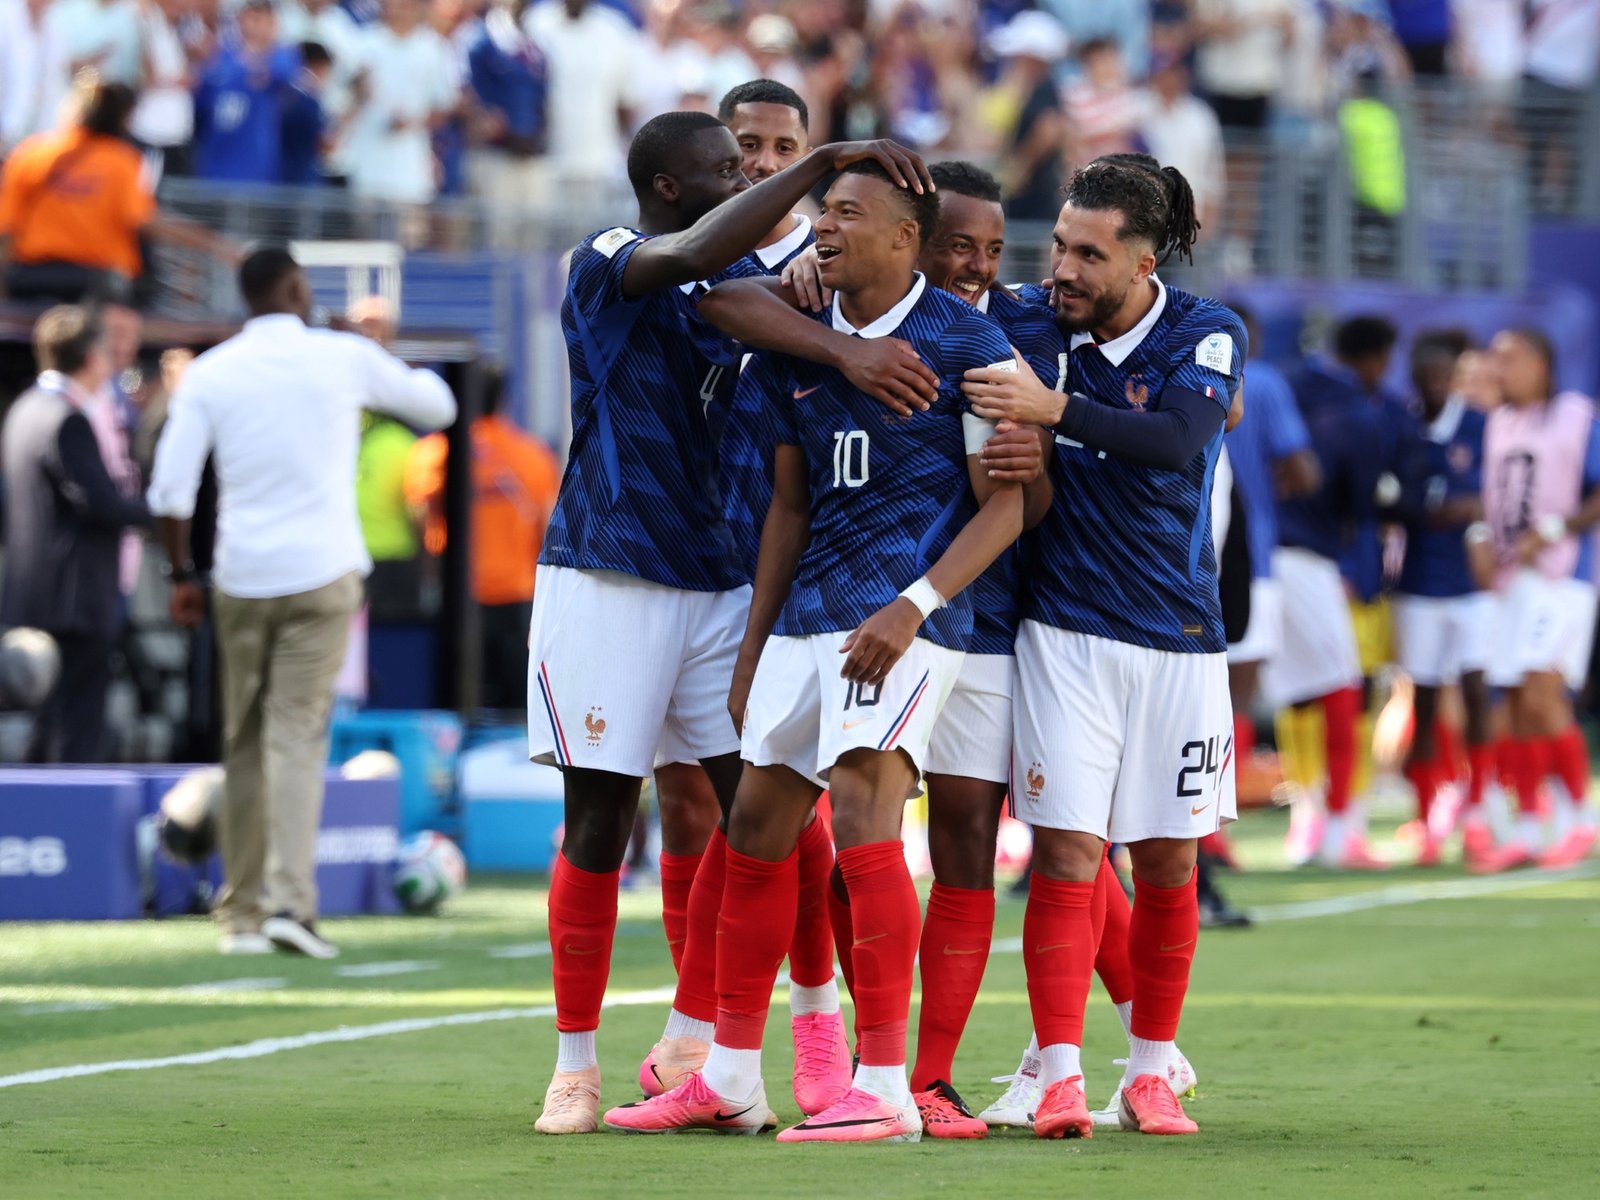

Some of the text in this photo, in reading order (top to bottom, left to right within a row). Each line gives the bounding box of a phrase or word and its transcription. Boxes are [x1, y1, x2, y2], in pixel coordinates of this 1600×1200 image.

[1206, 355, 1222, 364] PEACE
[832, 430, 870, 488] 10
[1176, 734, 1220, 797] 24
[0, 835, 67, 877] 26
